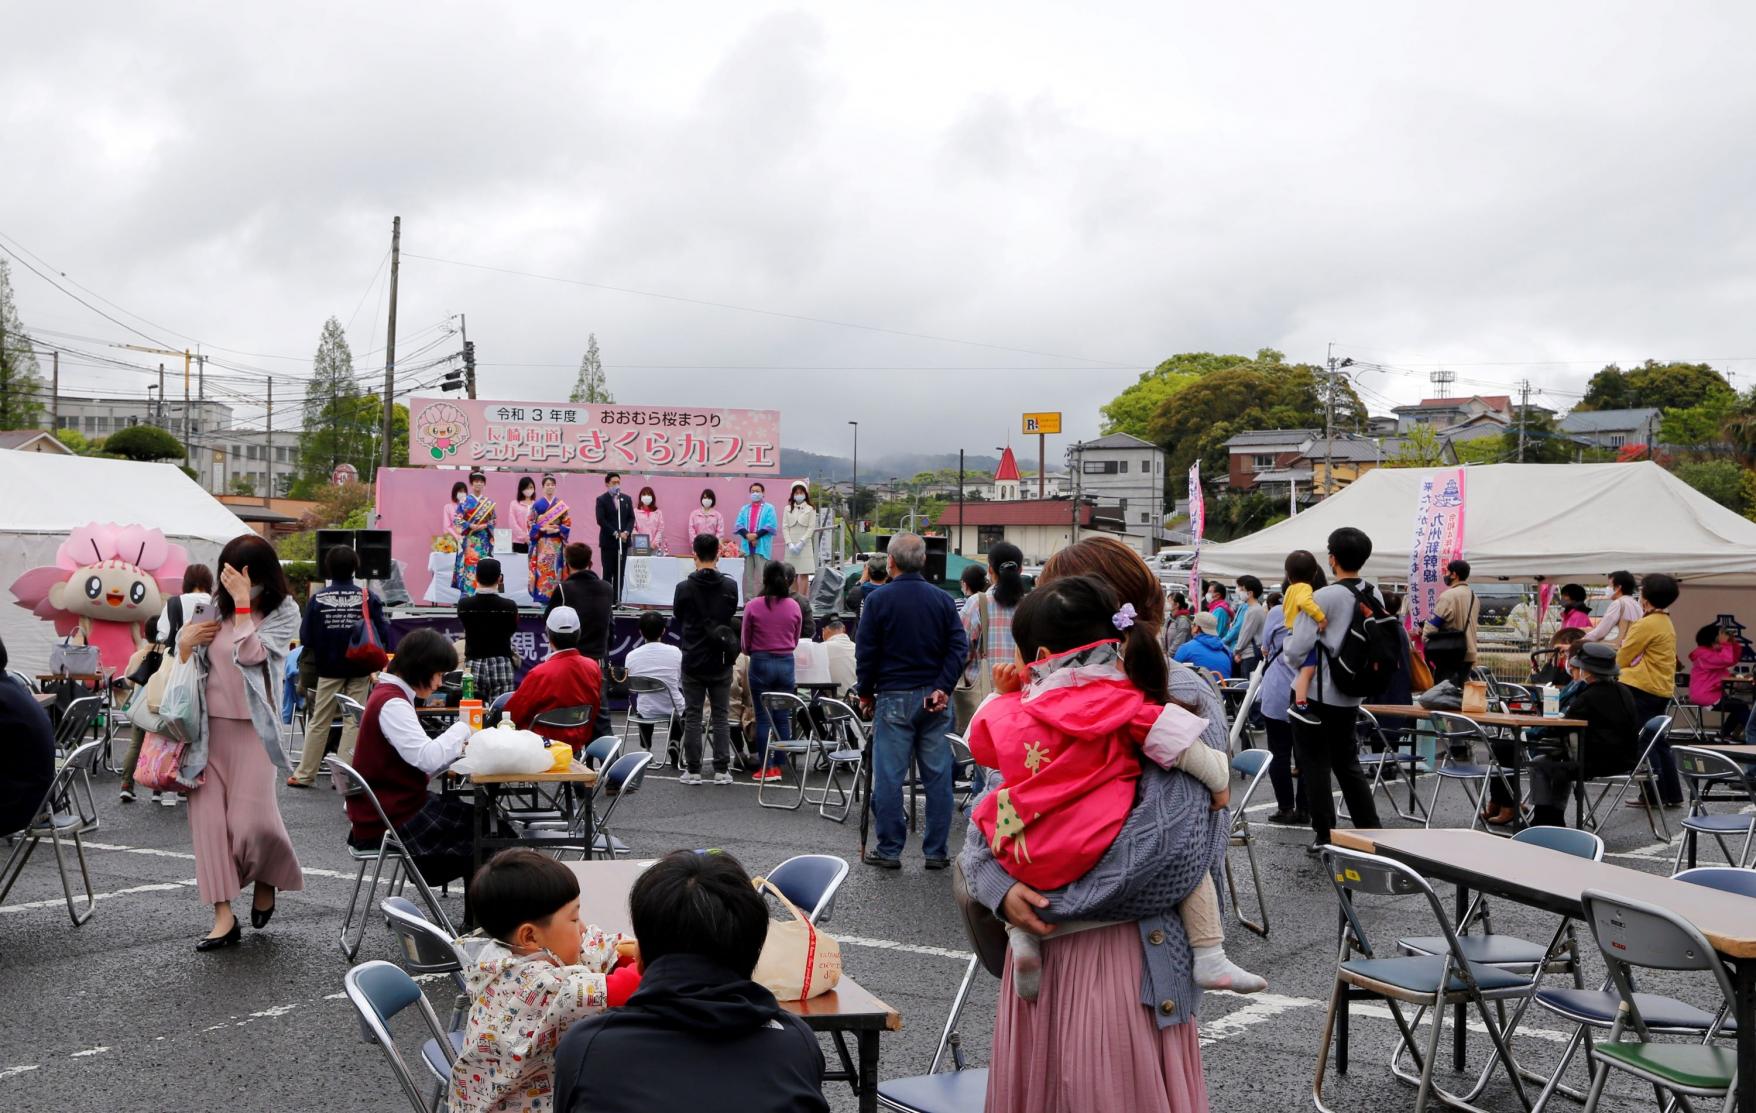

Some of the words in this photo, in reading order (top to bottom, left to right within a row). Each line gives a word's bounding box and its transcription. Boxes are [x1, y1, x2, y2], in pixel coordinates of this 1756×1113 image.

[600, 409, 722, 428] おおむら桜まつり
[487, 427, 563, 444] 長崎街道
[471, 443, 576, 463] シュガーロード
[577, 430, 775, 466] さくらカフェ
